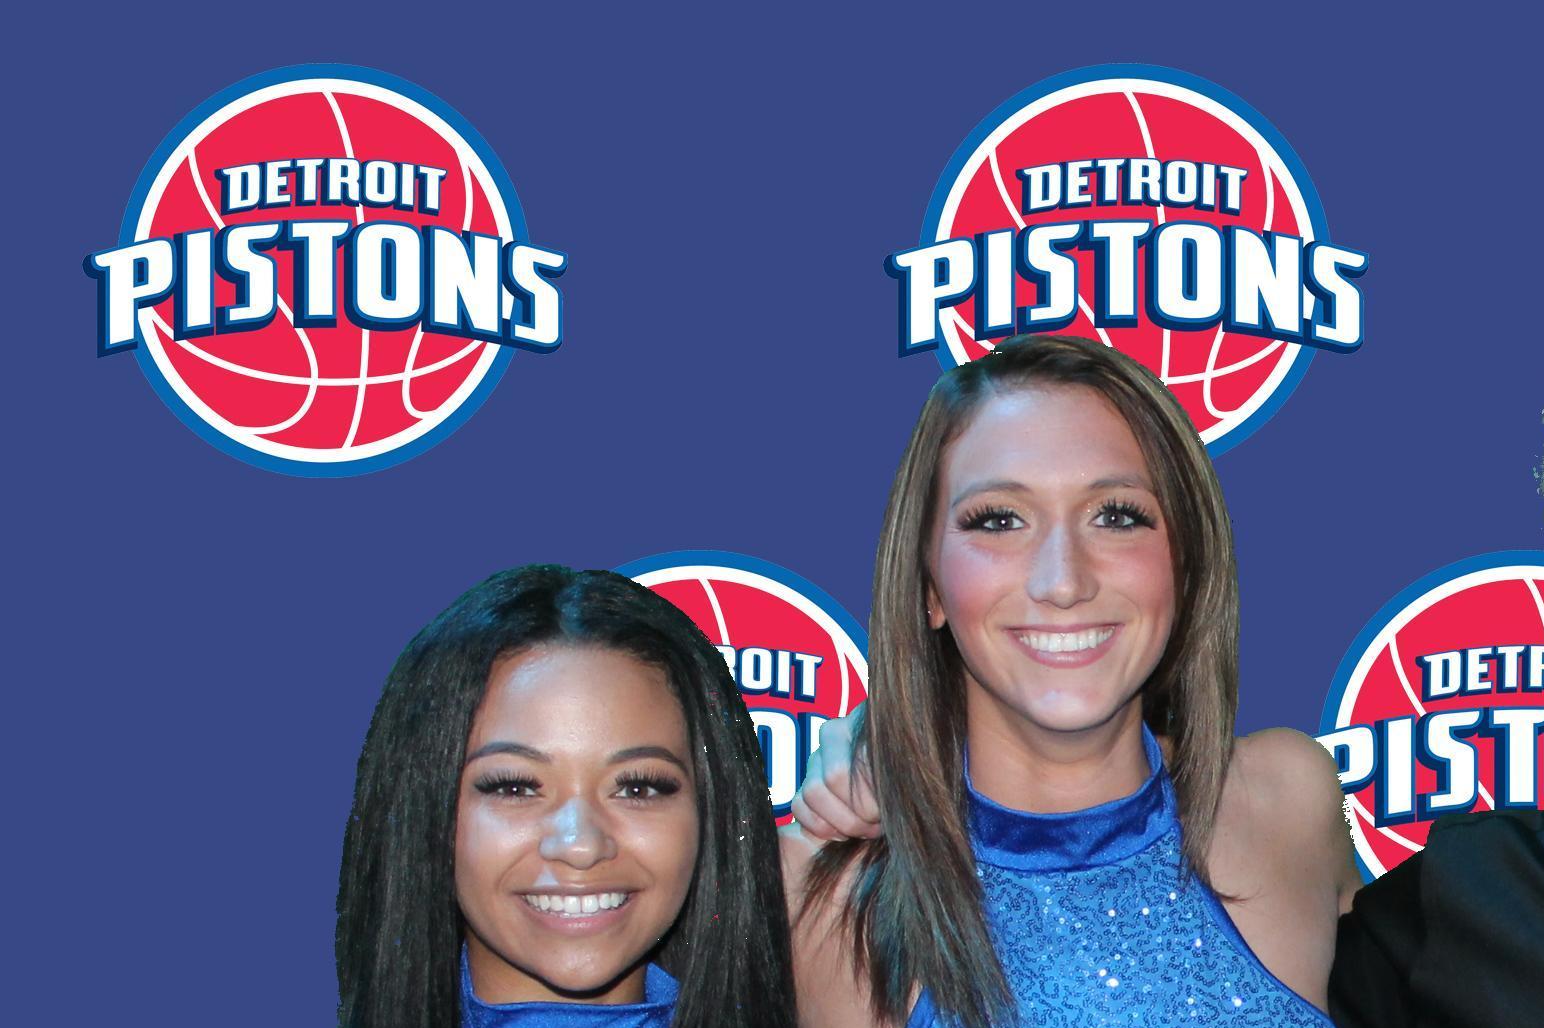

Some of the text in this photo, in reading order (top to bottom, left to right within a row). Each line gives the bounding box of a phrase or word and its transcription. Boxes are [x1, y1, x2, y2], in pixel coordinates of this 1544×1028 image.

[218, 157, 447, 212] DETROIT
[1018, 157, 1247, 212] DETROIT
[88, 220, 567, 354] PISTONS
[888, 220, 1367, 354] PISTONS
